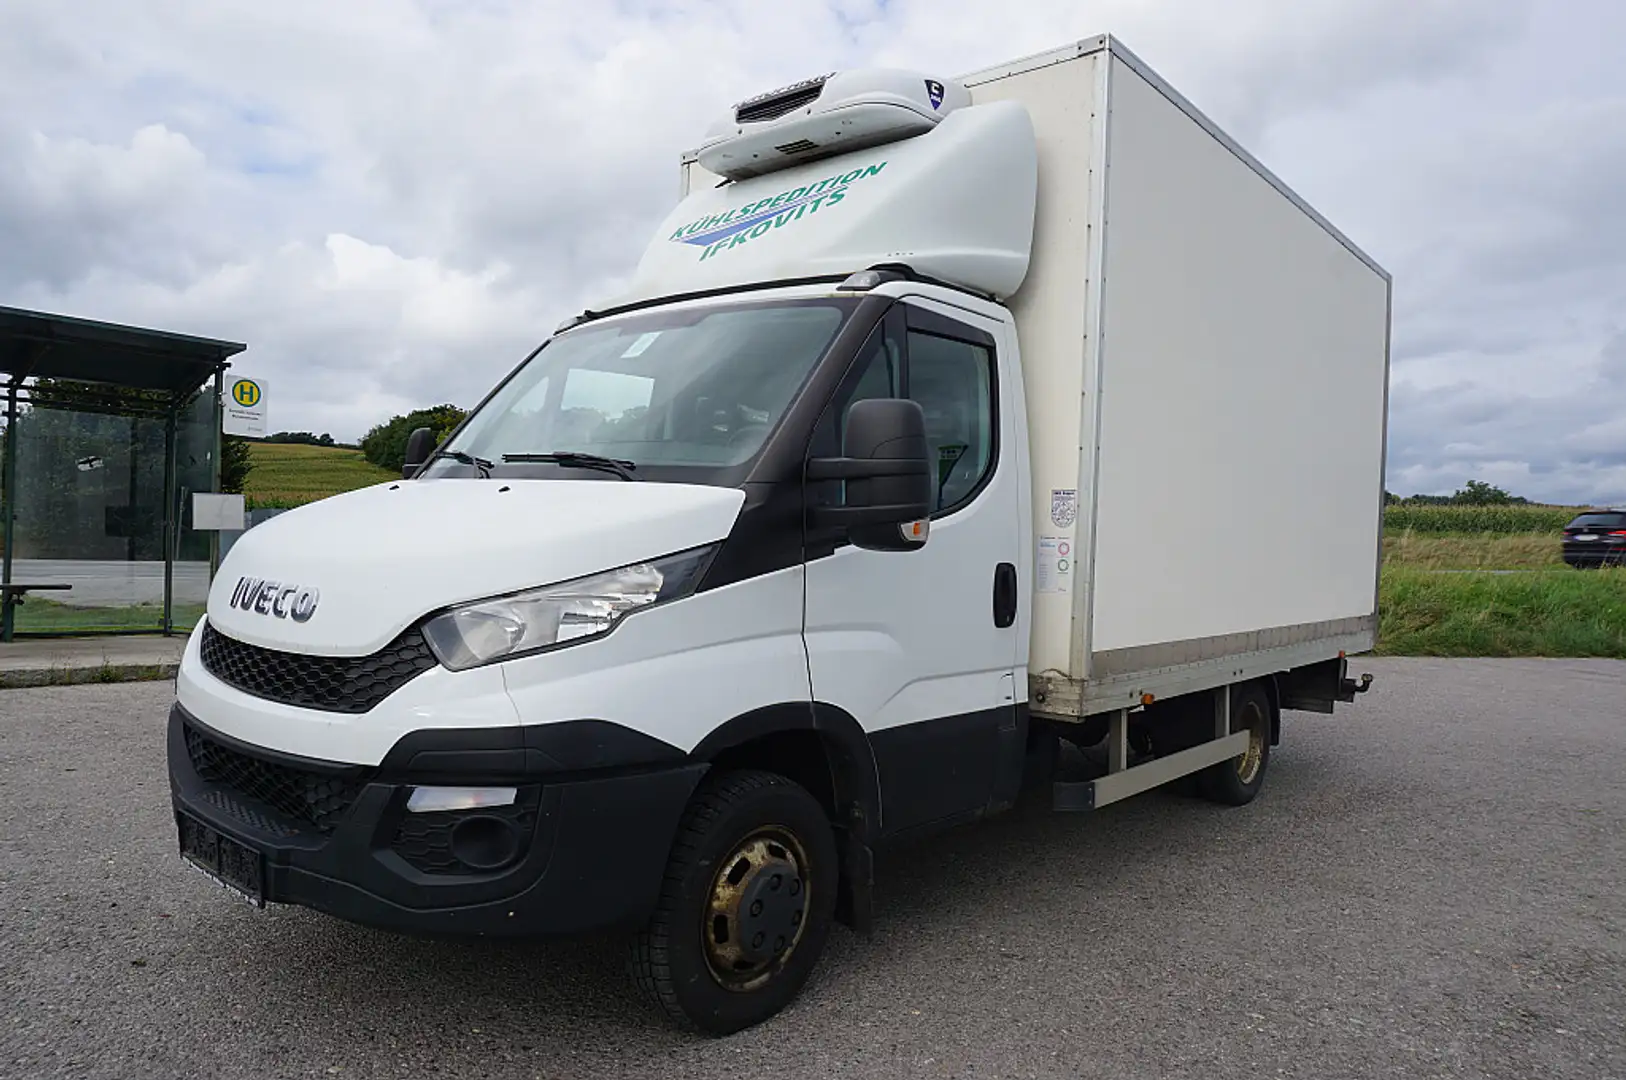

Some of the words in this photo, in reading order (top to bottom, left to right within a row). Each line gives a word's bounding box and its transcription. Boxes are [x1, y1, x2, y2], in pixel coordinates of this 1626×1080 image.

[669, 161, 888, 241] KÜHLSPEDITION
[699, 186, 848, 262] IFKOVITS
[240, 384, 254, 402] H
[229, 576, 319, 623] IVECO
